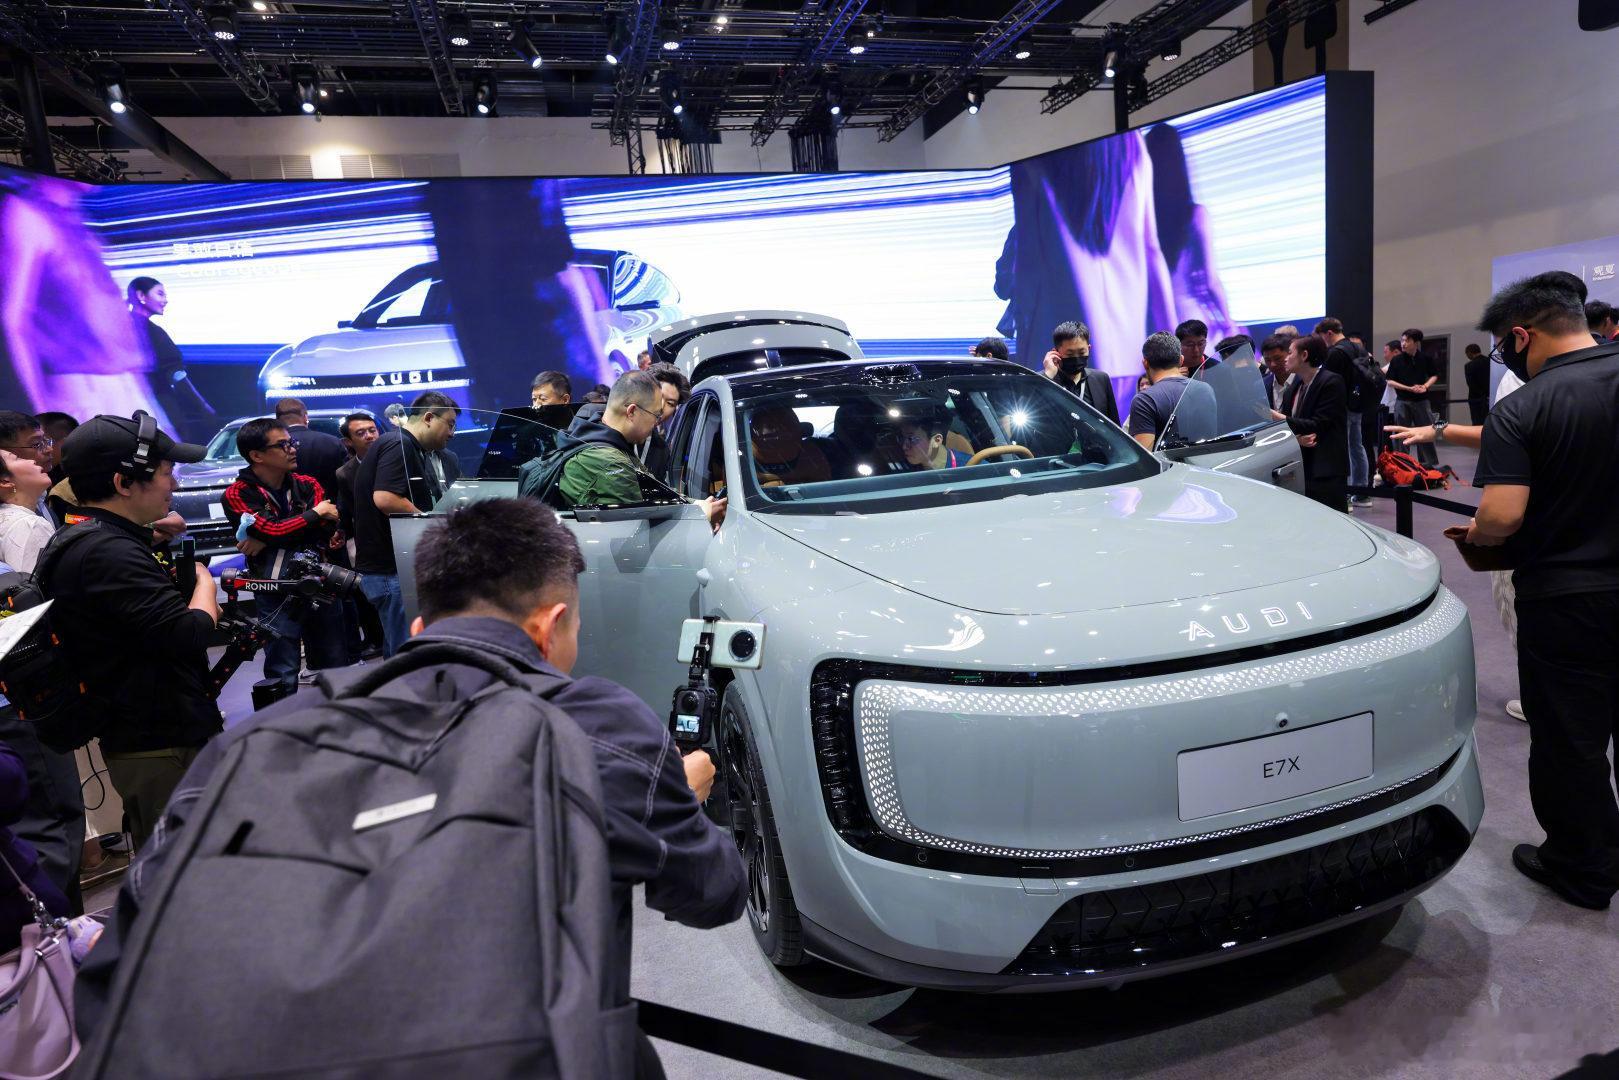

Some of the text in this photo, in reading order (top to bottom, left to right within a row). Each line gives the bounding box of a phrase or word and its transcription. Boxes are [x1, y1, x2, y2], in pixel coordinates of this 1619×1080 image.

[372, 370, 434, 386] AUDI
[245, 582, 279, 591] RONIN
[1188, 601, 1313, 641] AUDI
[1263, 756, 1301, 779] E7X
